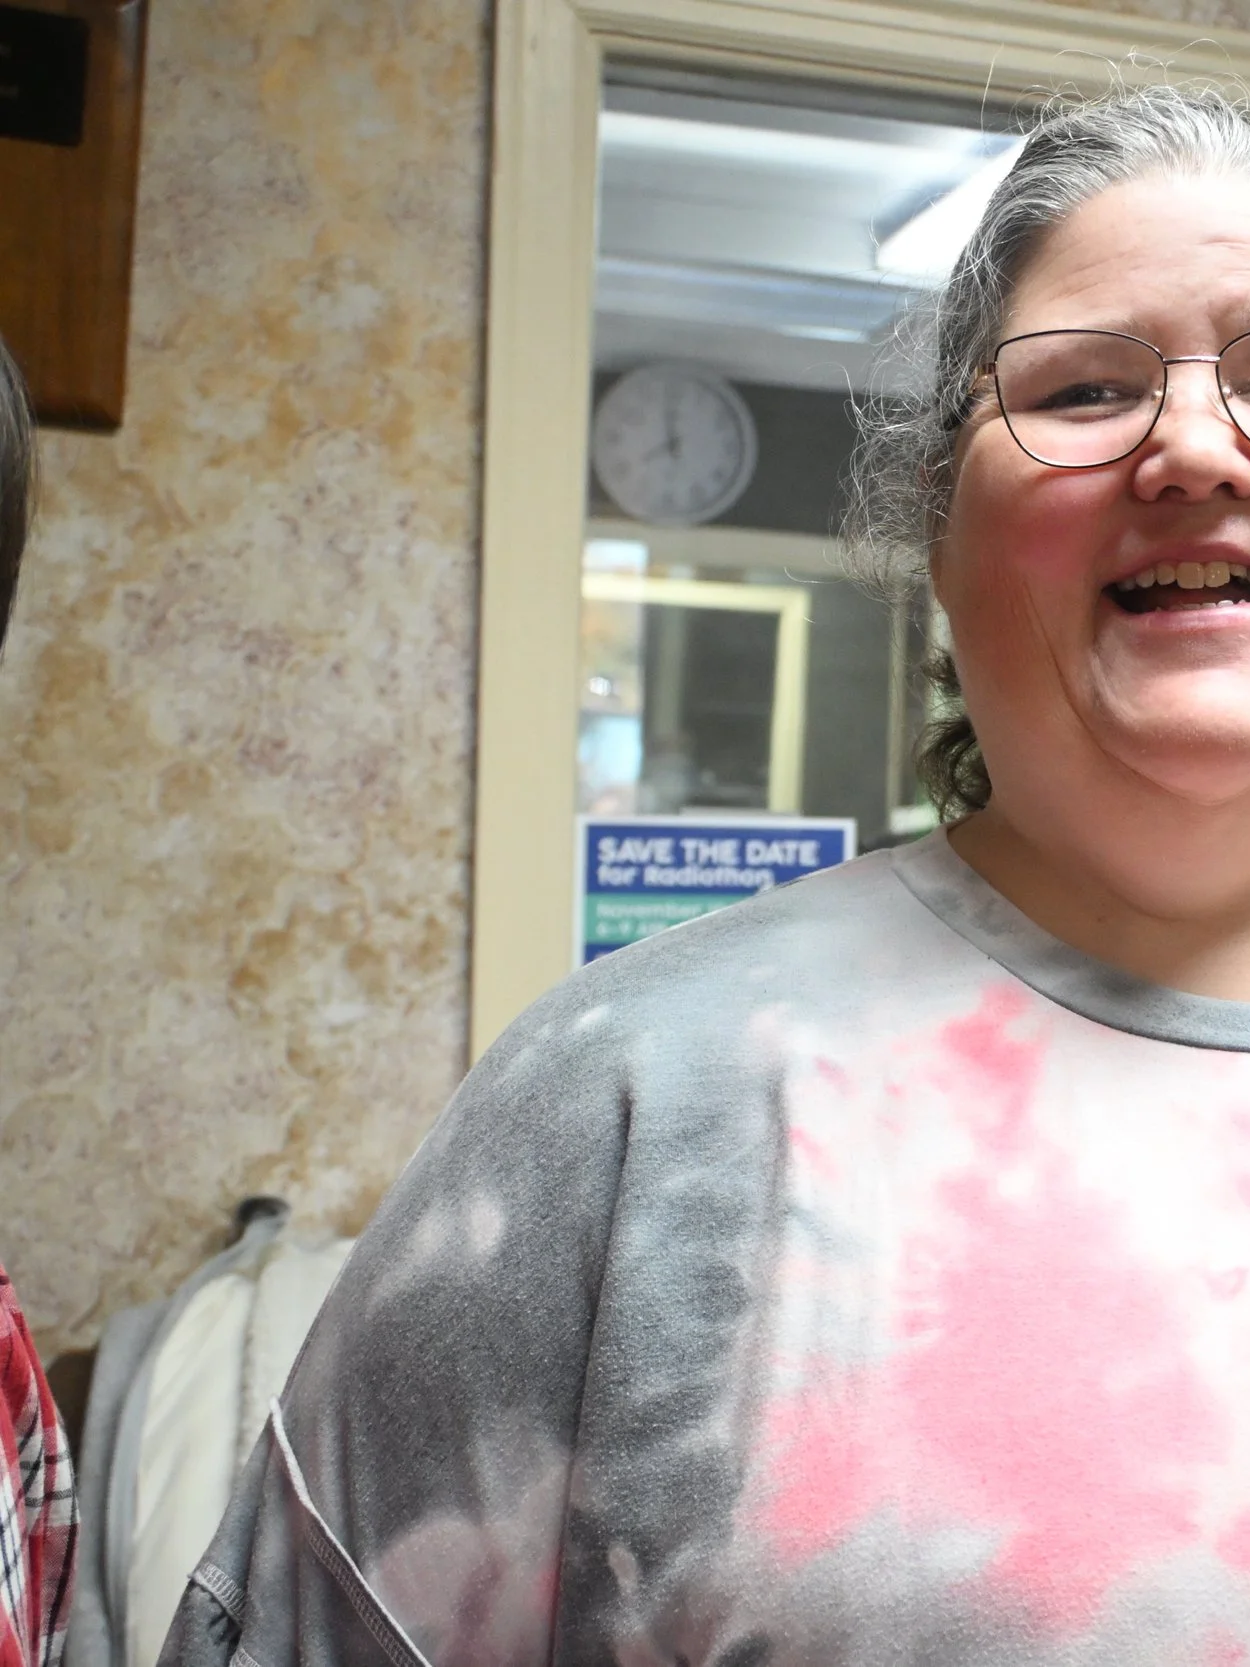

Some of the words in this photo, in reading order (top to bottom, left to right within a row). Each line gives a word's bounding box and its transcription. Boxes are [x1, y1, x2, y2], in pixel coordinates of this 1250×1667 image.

[598, 836, 672, 864] SAVE
[680, 838, 739, 865] THE
[745, 839, 819, 867] DATE
[598, 865, 637, 886] for
[643, 865, 774, 888] Radiothon
